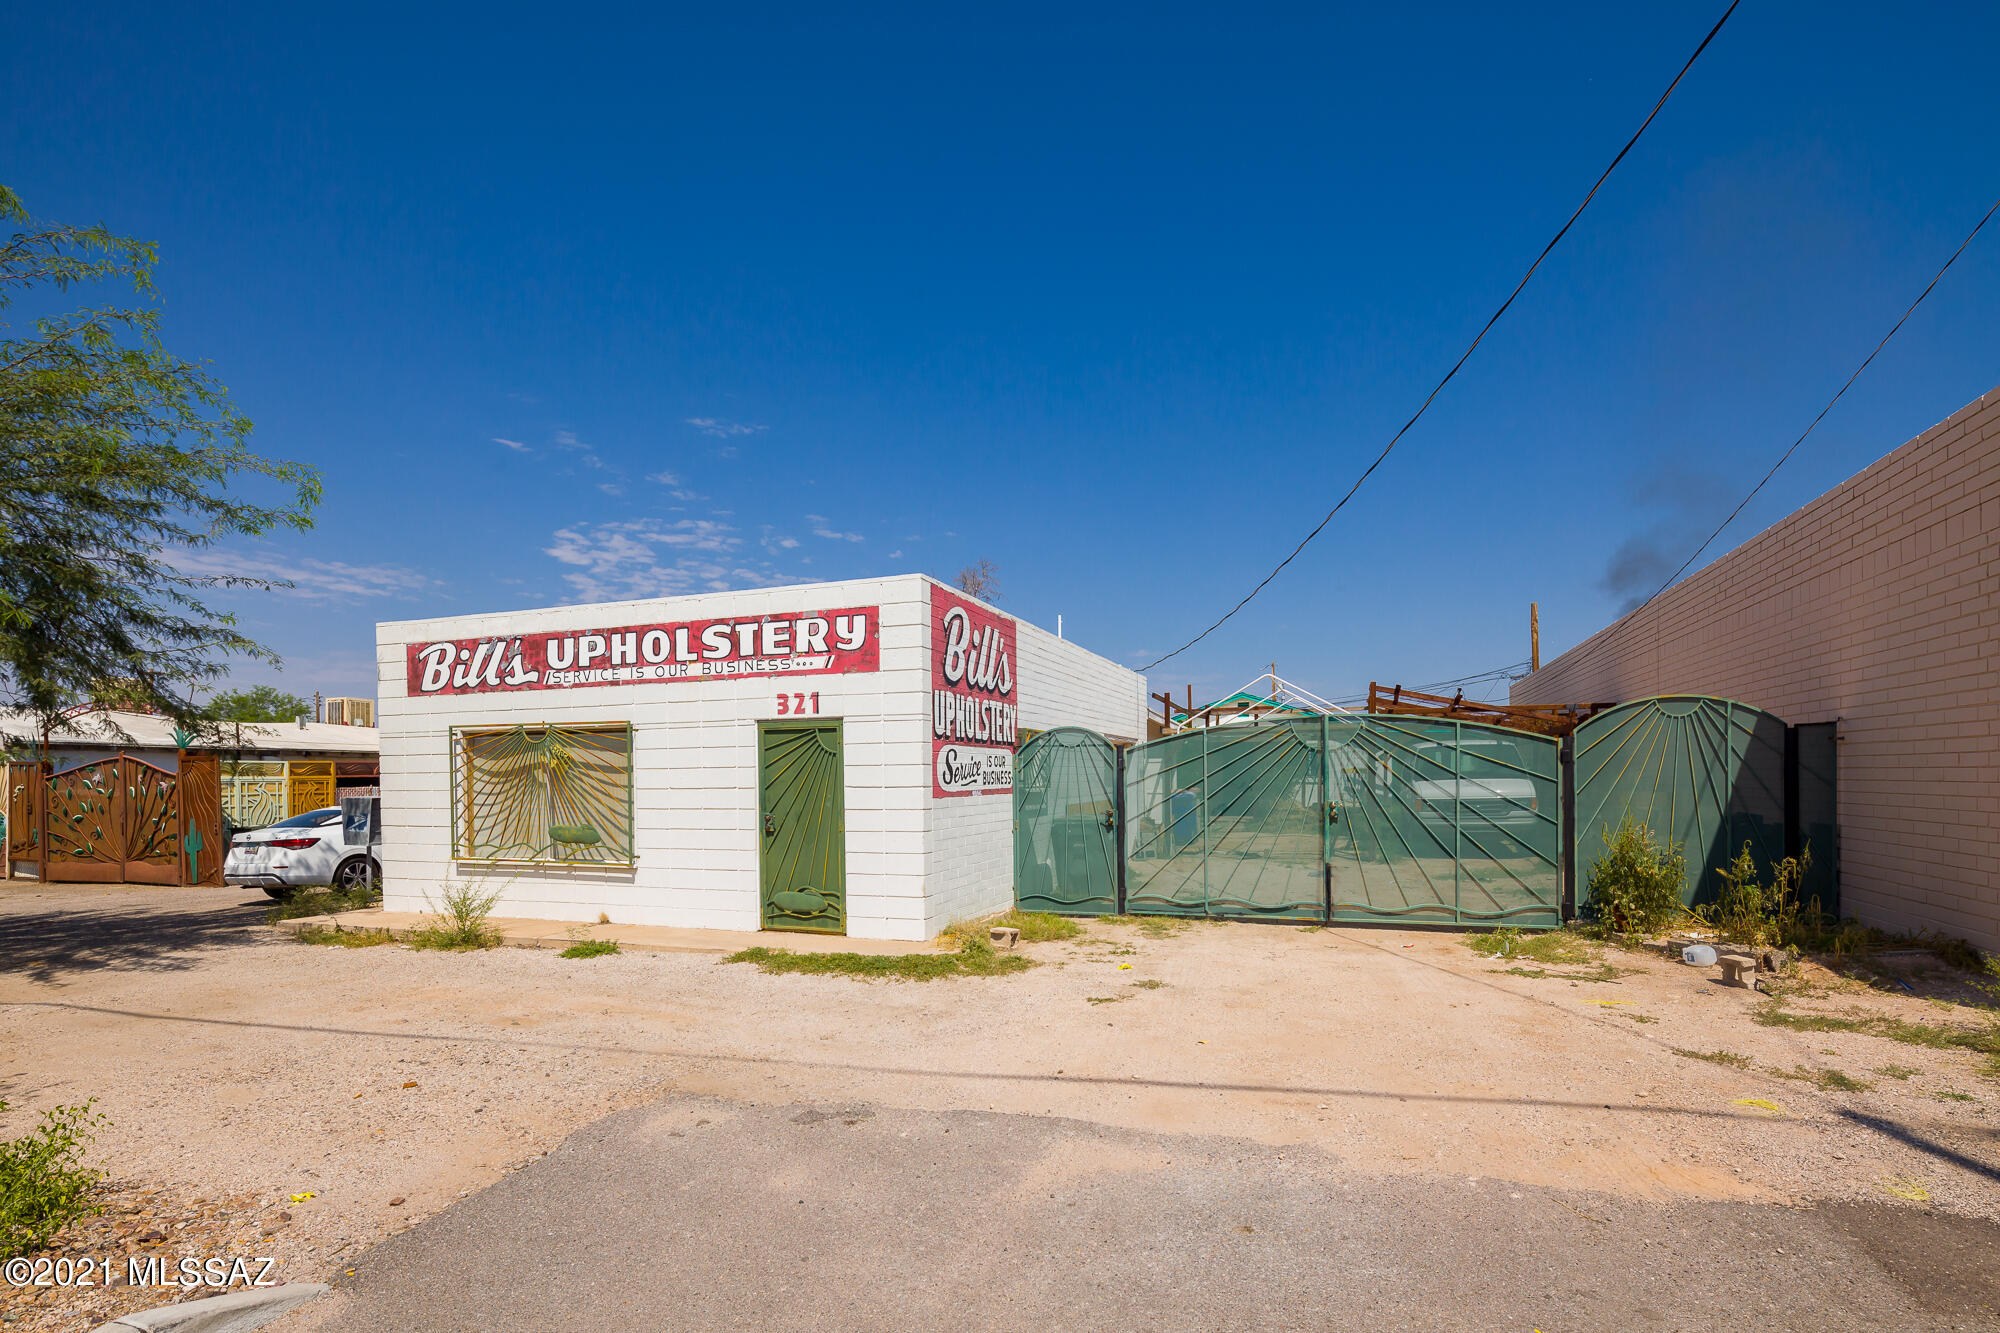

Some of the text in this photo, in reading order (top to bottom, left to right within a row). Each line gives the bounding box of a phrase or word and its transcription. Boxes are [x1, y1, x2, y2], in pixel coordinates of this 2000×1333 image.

[418, 614, 867, 692] Bill's UPHOLSTERY
[630, 665, 645, 679] IS
[654, 664, 689, 678] OUR
[943, 606, 1013, 697] Bill's
[776, 691, 820, 716] 321
[933, 690, 1016, 745] UPHOLSTERY
[942, 748, 1006, 785] Service IS OUR
